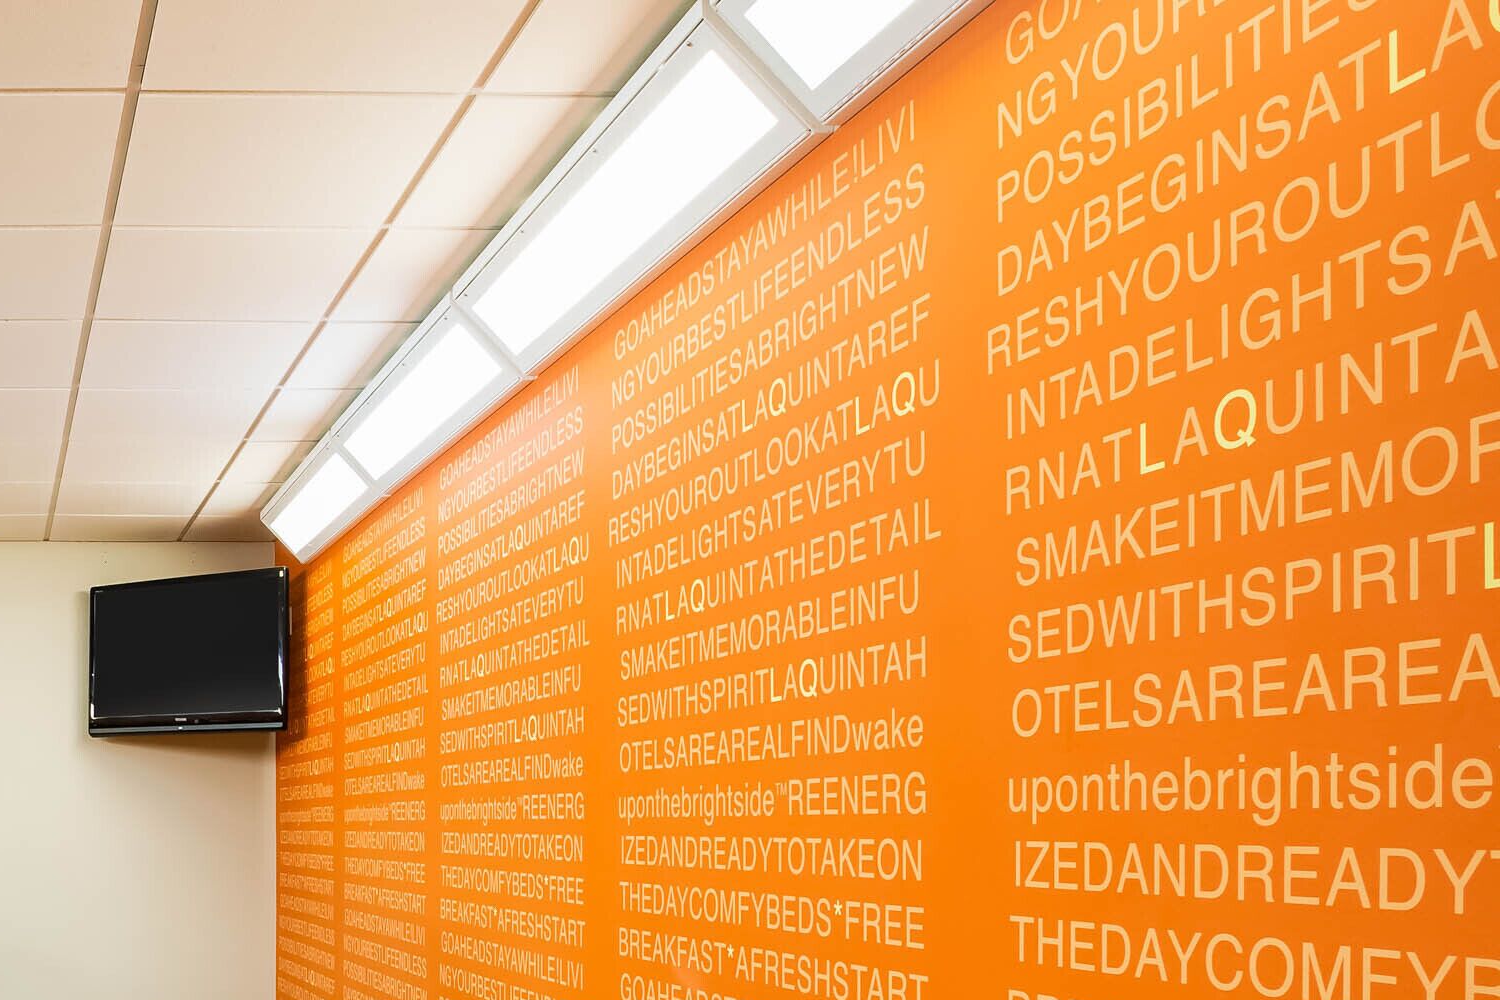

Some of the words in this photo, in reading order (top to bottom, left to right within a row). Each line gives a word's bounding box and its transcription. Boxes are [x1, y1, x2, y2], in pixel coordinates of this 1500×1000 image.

[998, 0, 1371, 223] POSSIBILITIE
[998, 0, 1500, 297] DAYBEGINSATLA
[612, 156, 924, 409] NGYOURBESTLIFEENDLESS
[612, 221, 929, 454] POSSIBILITIESABRIGHTNEW
[1007, 185, 1500, 441] INTADELIGHTSA
[608, 353, 940, 547] RESHYOUROUTLOOKATLAQU
[612, 290, 929, 499] DAYBEGINSATLAQUINTAREF
[1006, 296, 1498, 516] RNATLAQUINTA
[437, 401, 582, 525] NGYOURBESTLIFEENDLESS
[437, 443, 585, 558] POSSIBILITIESABRIGHTNEW
[616, 429, 924, 589] INTADELIGHTSATEVERYTU
[436, 528, 588, 625] RESHYOUROUTLOOKATLAQU
[438, 486, 585, 591] DAYBEGINSATLAQUINTAREF
[616, 493, 938, 635] RNATLAQUINTATHEDETAIL
[440, 574, 582, 656] INTADELIGHTSATEVERYTU
[440, 616, 588, 689] RNATLAQUINTATHEDETAIL
[621, 568, 917, 680] SMAKEITMEMORABLEINFU
[440, 703, 583, 754] SEDWITHSPIRITLAQUINTAH
[442, 662, 580, 721] SMAKEITMEMORABLEINFU
[618, 632, 925, 725] SEDWITHSPIRITLAQUINTAH
[1012, 622, 1500, 736] OTELSAREAREA
[441, 746, 582, 786] OTELSAREAREALFINDwake
[619, 700, 922, 771] OTELSAREAREALFINDwake
[441, 831, 582, 860] IZEDANDREADYTOTAKEON
[621, 834, 921, 880] IZEDANDREADYTOTAKEON
[1016, 838, 1500, 913] IZEDANDREADY
